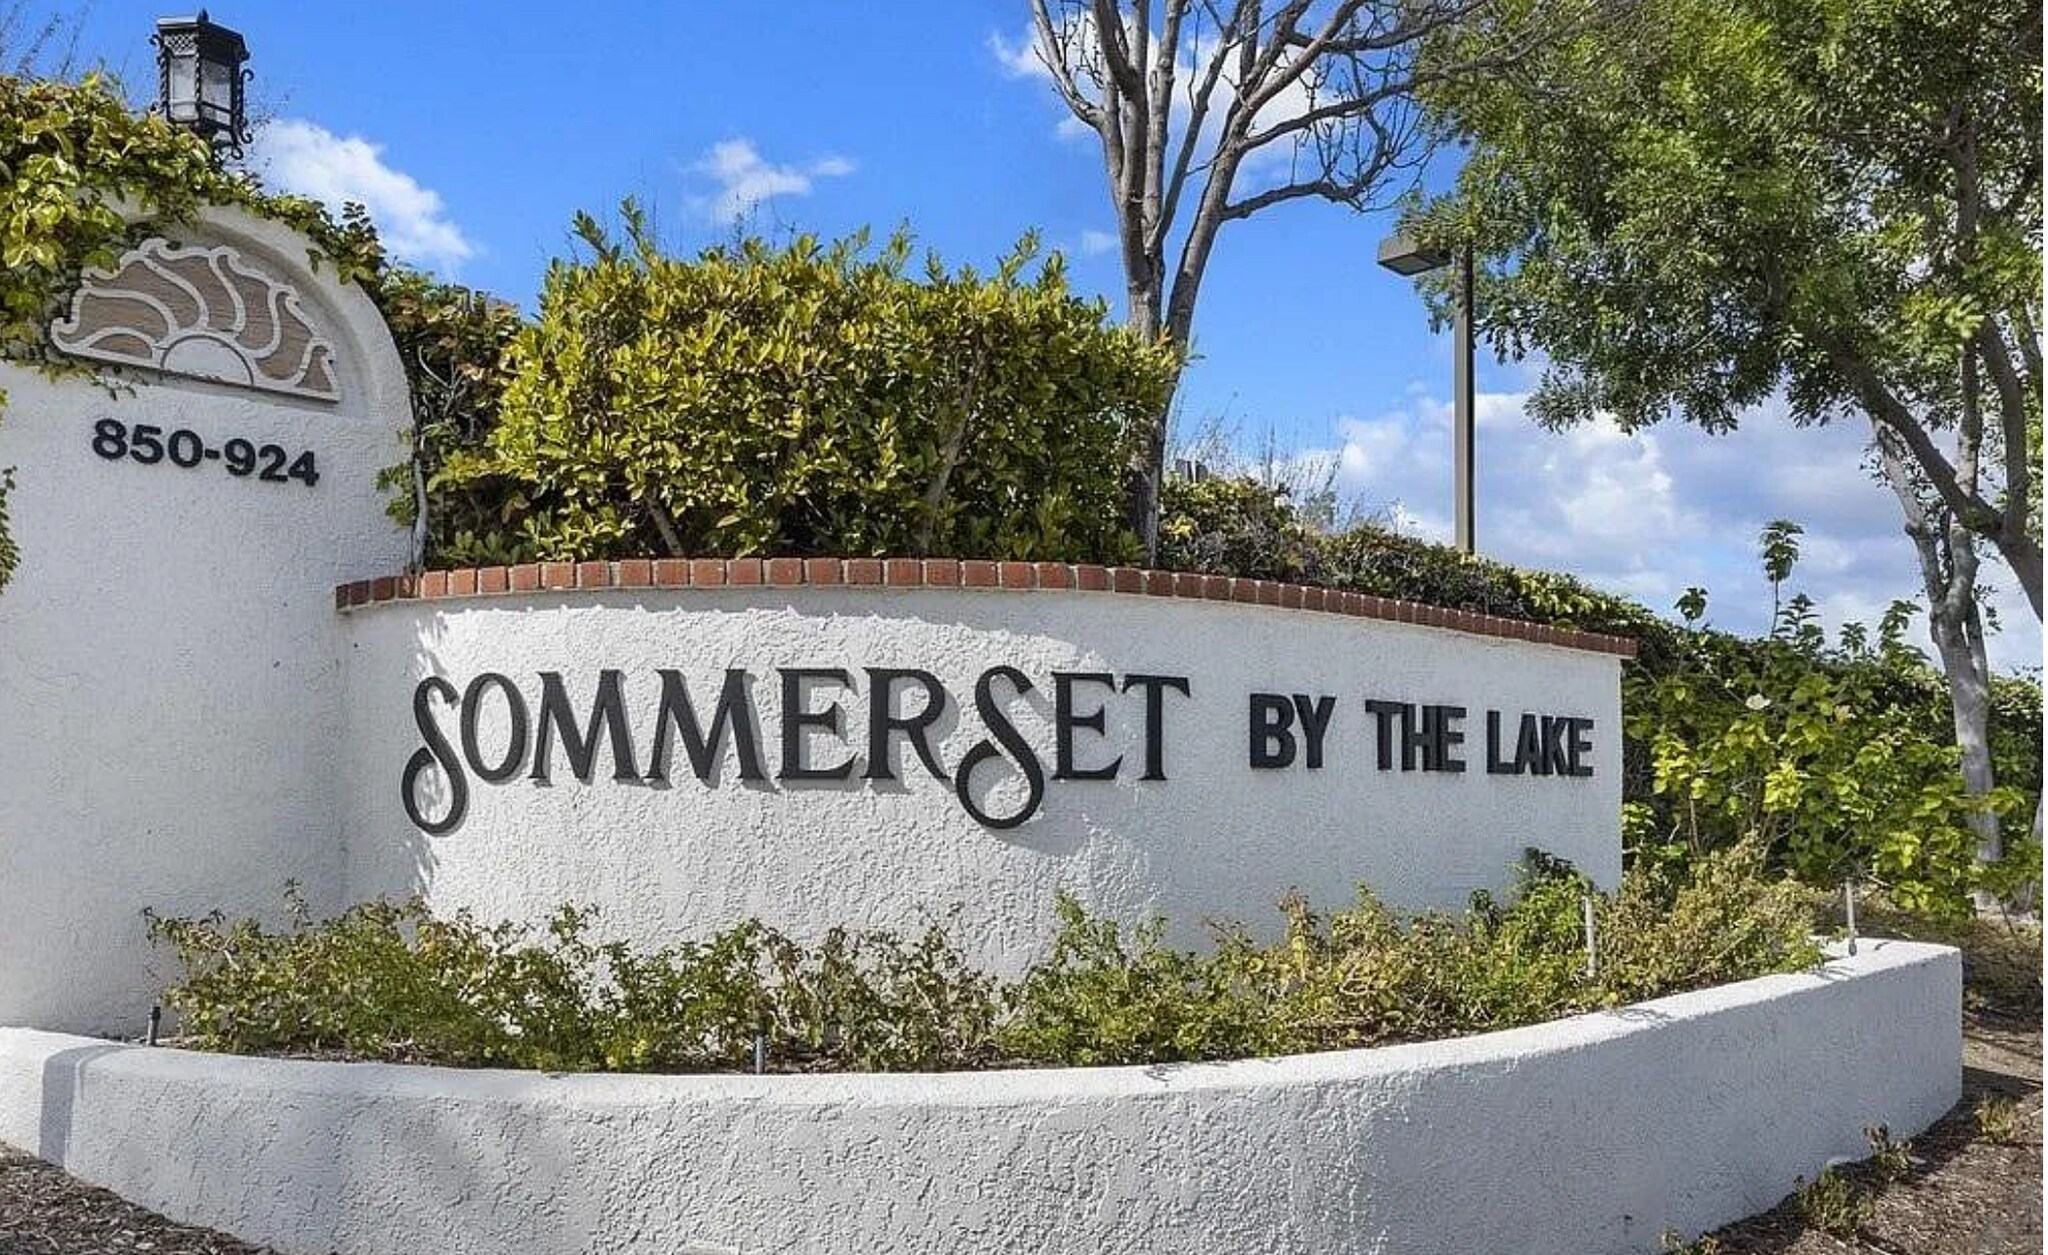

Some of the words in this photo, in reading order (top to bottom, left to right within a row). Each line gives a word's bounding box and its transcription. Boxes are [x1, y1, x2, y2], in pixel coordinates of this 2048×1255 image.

[92, 418, 321, 488] 850-924
[401, 665, 1191, 836] SOMMERSET
[1249, 693, 1337, 770] BY
[1364, 699, 1467, 773] THE
[1486, 710, 1594, 778] LAKE
